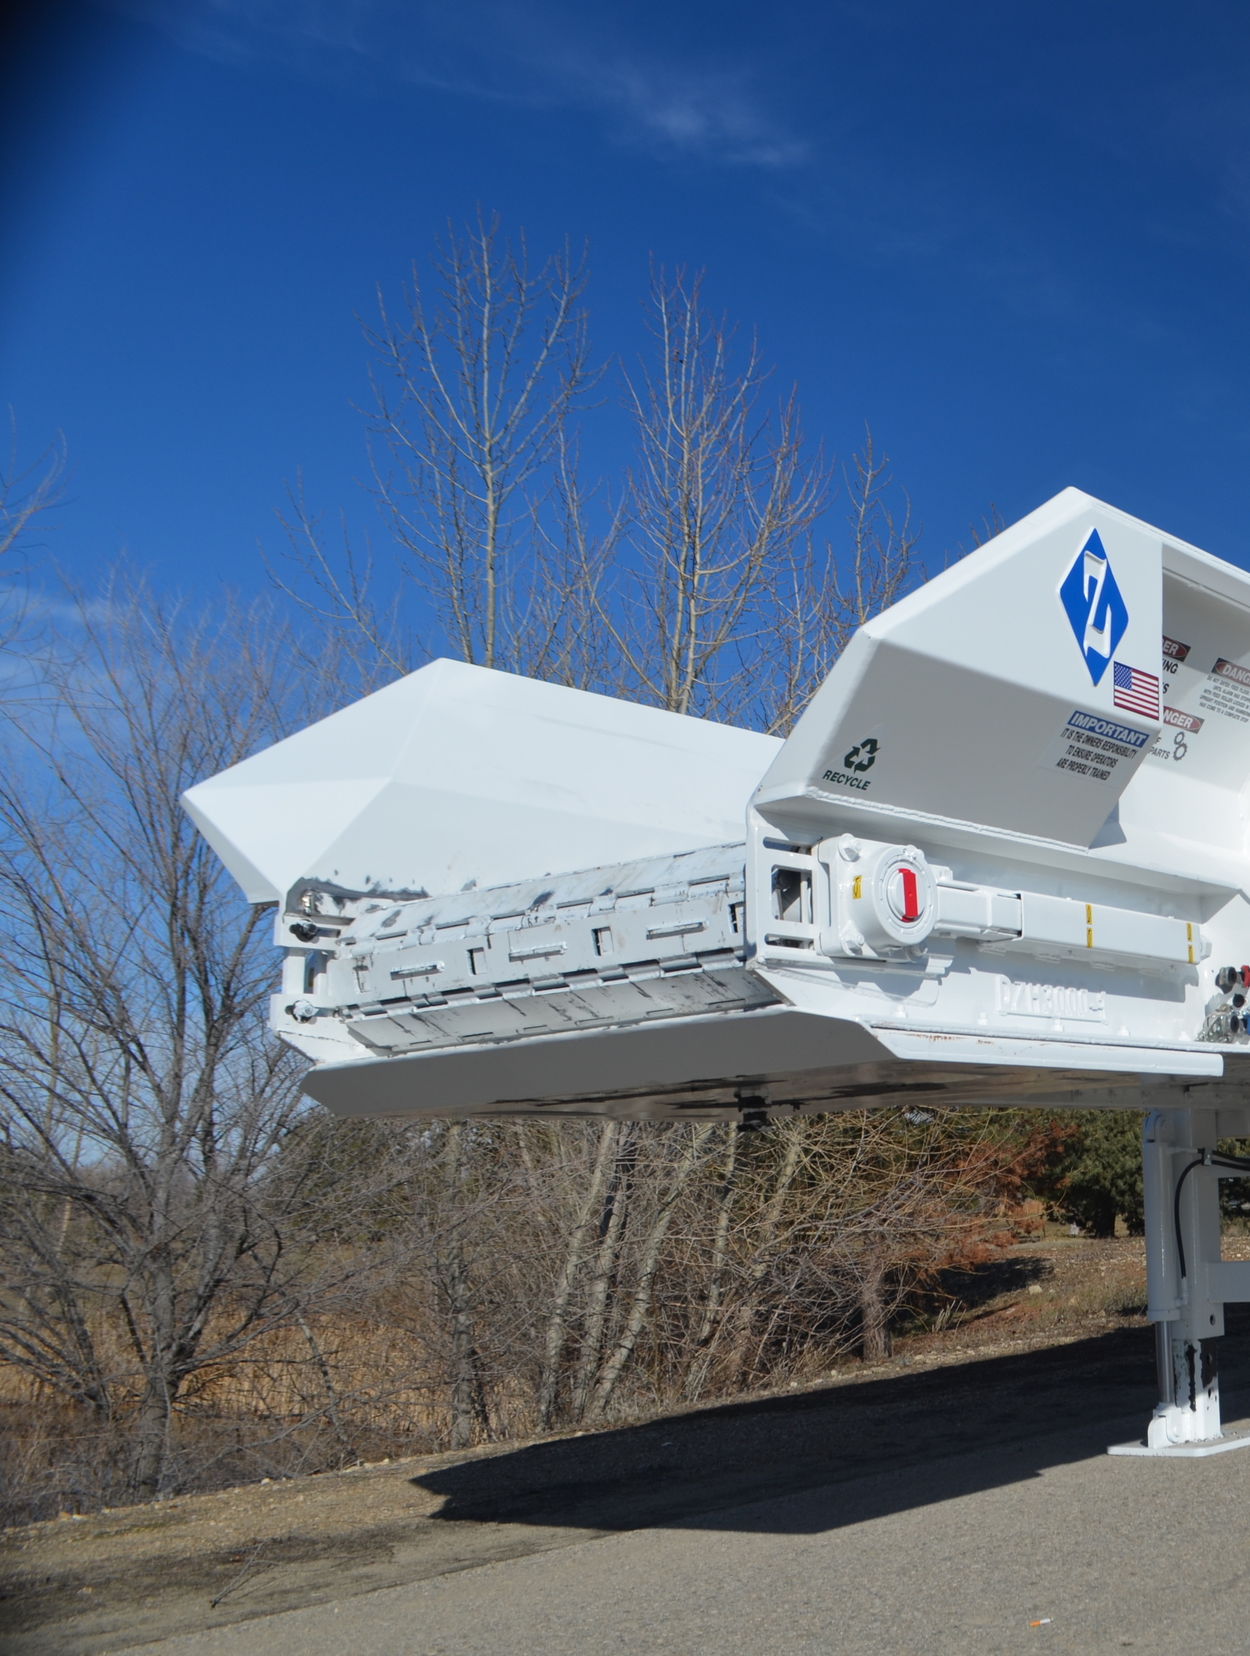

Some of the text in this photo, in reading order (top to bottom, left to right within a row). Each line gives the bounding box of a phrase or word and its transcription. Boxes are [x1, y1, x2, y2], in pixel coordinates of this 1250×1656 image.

[1070, 712, 1147, 746] IMPORTANT
[1163, 709, 1194, 728] NGER
[1060, 728, 1138, 759] IT IS THE OWNERS RESPONSIBILITY
[1066, 744, 1119, 768] TO ENSURE OPERATORS
[822, 769, 871, 791] RECYCLE
[1055, 757, 1111, 781] ARE PROPERLY TRAINED
